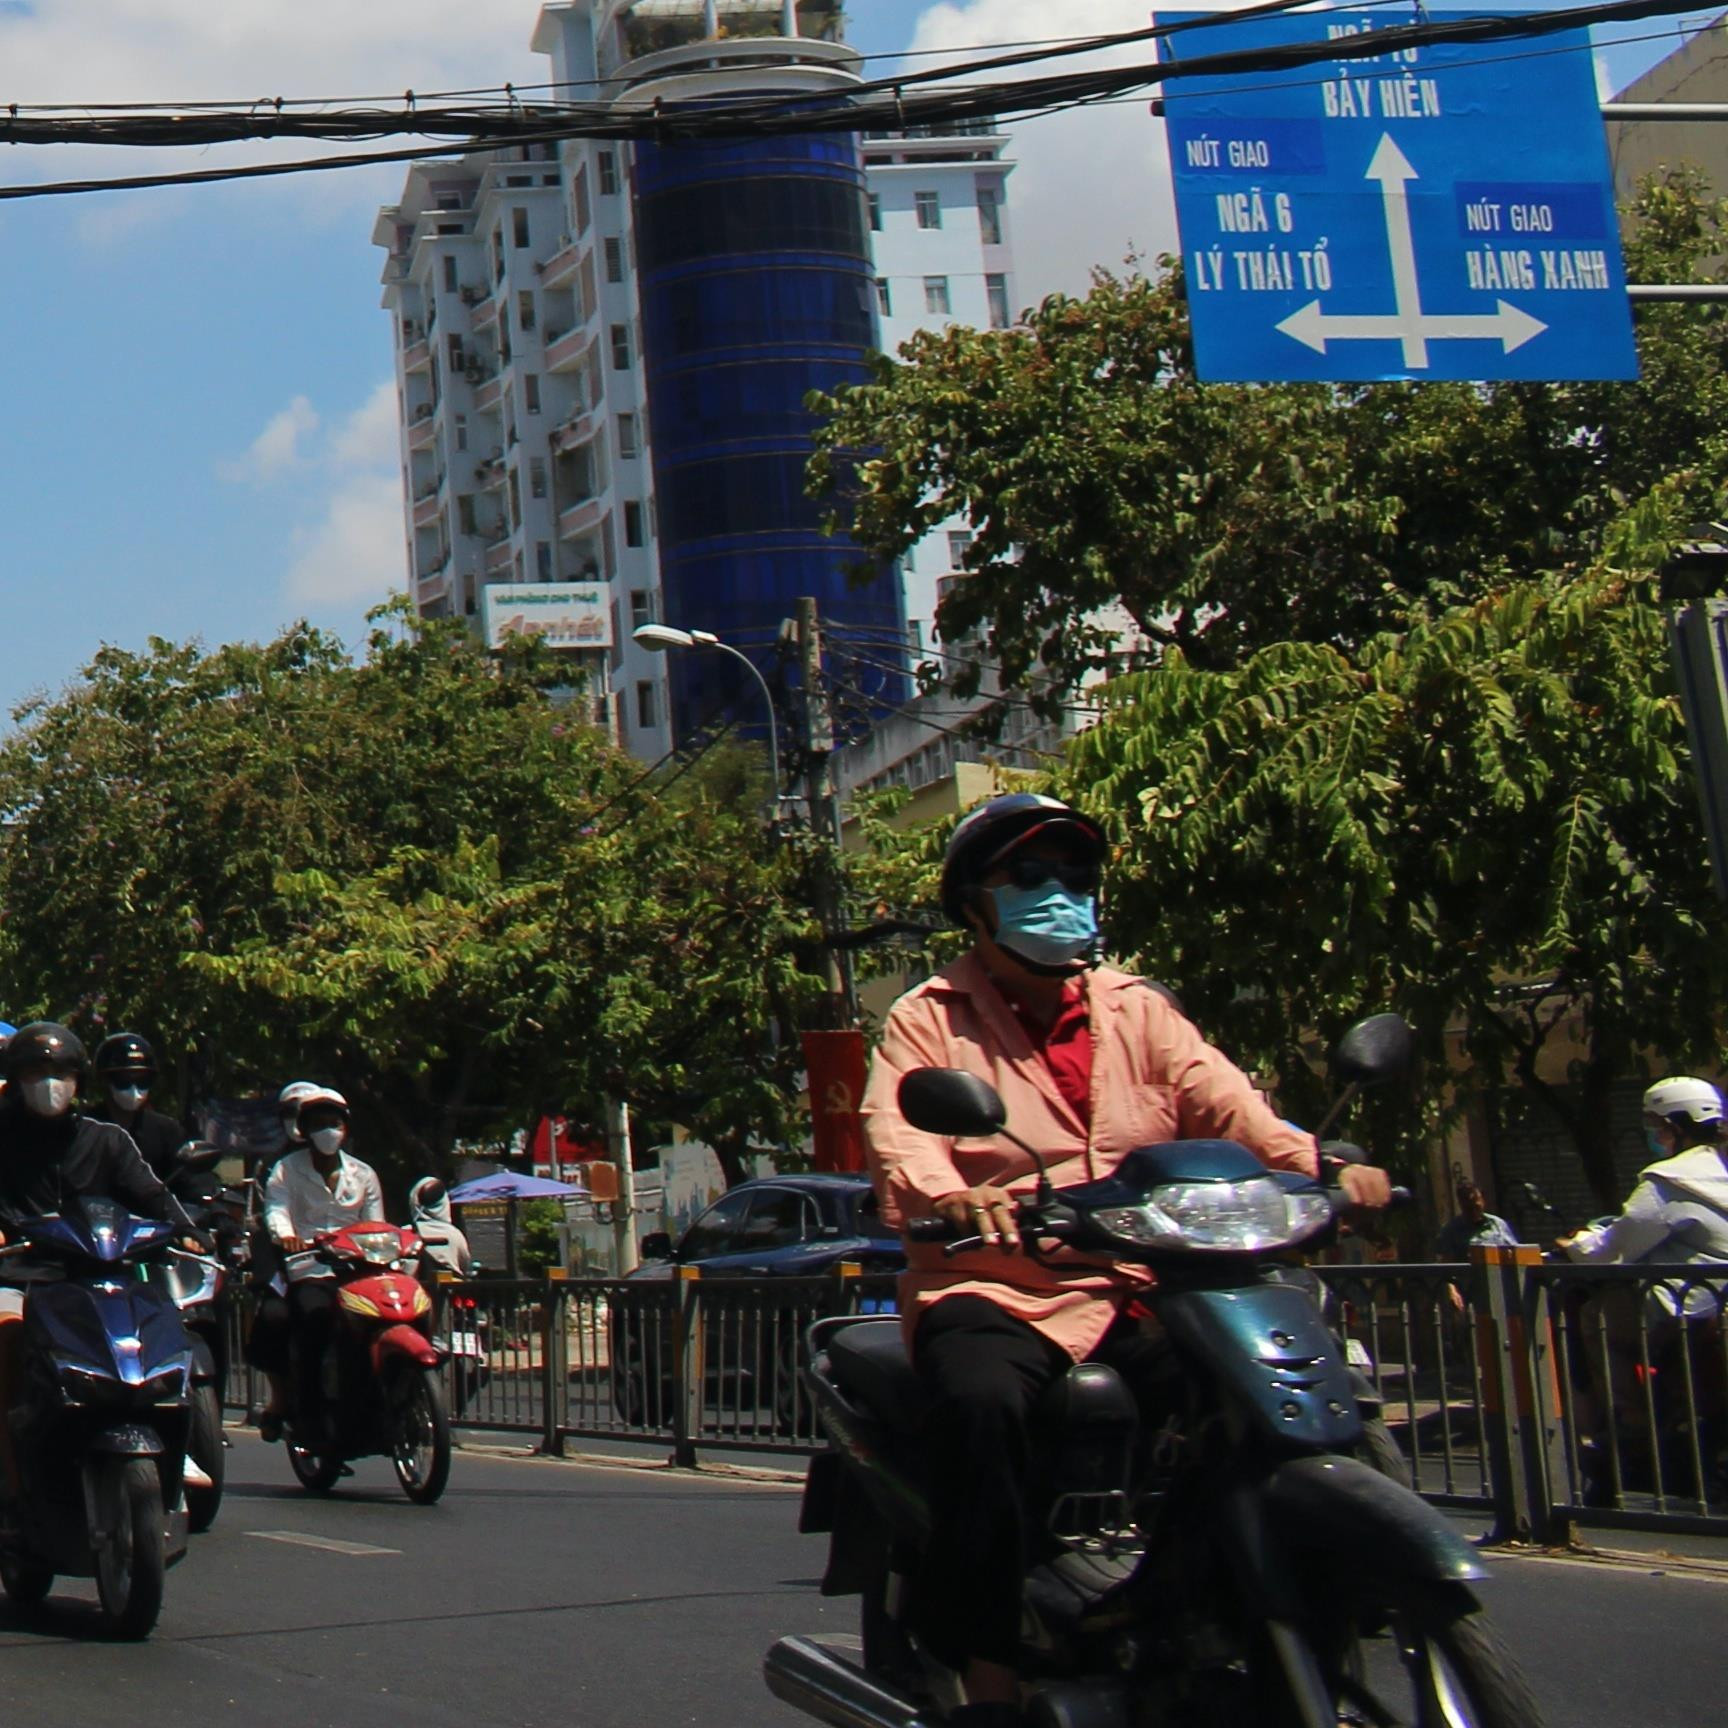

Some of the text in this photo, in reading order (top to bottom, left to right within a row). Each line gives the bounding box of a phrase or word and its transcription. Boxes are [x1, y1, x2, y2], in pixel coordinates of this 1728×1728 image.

[1322, 65, 1440, 118] BẢY HIỀN
[1186, 133, 1270, 168] NÚT GIAO
[1216, 186, 1293, 233] NGÃ 6
[1466, 196, 1553, 232] NÚT GIAO
[1194, 236, 1332, 291] LÝ THÁI TỔ
[1466, 243, 1609, 290] HÀNG XANH
